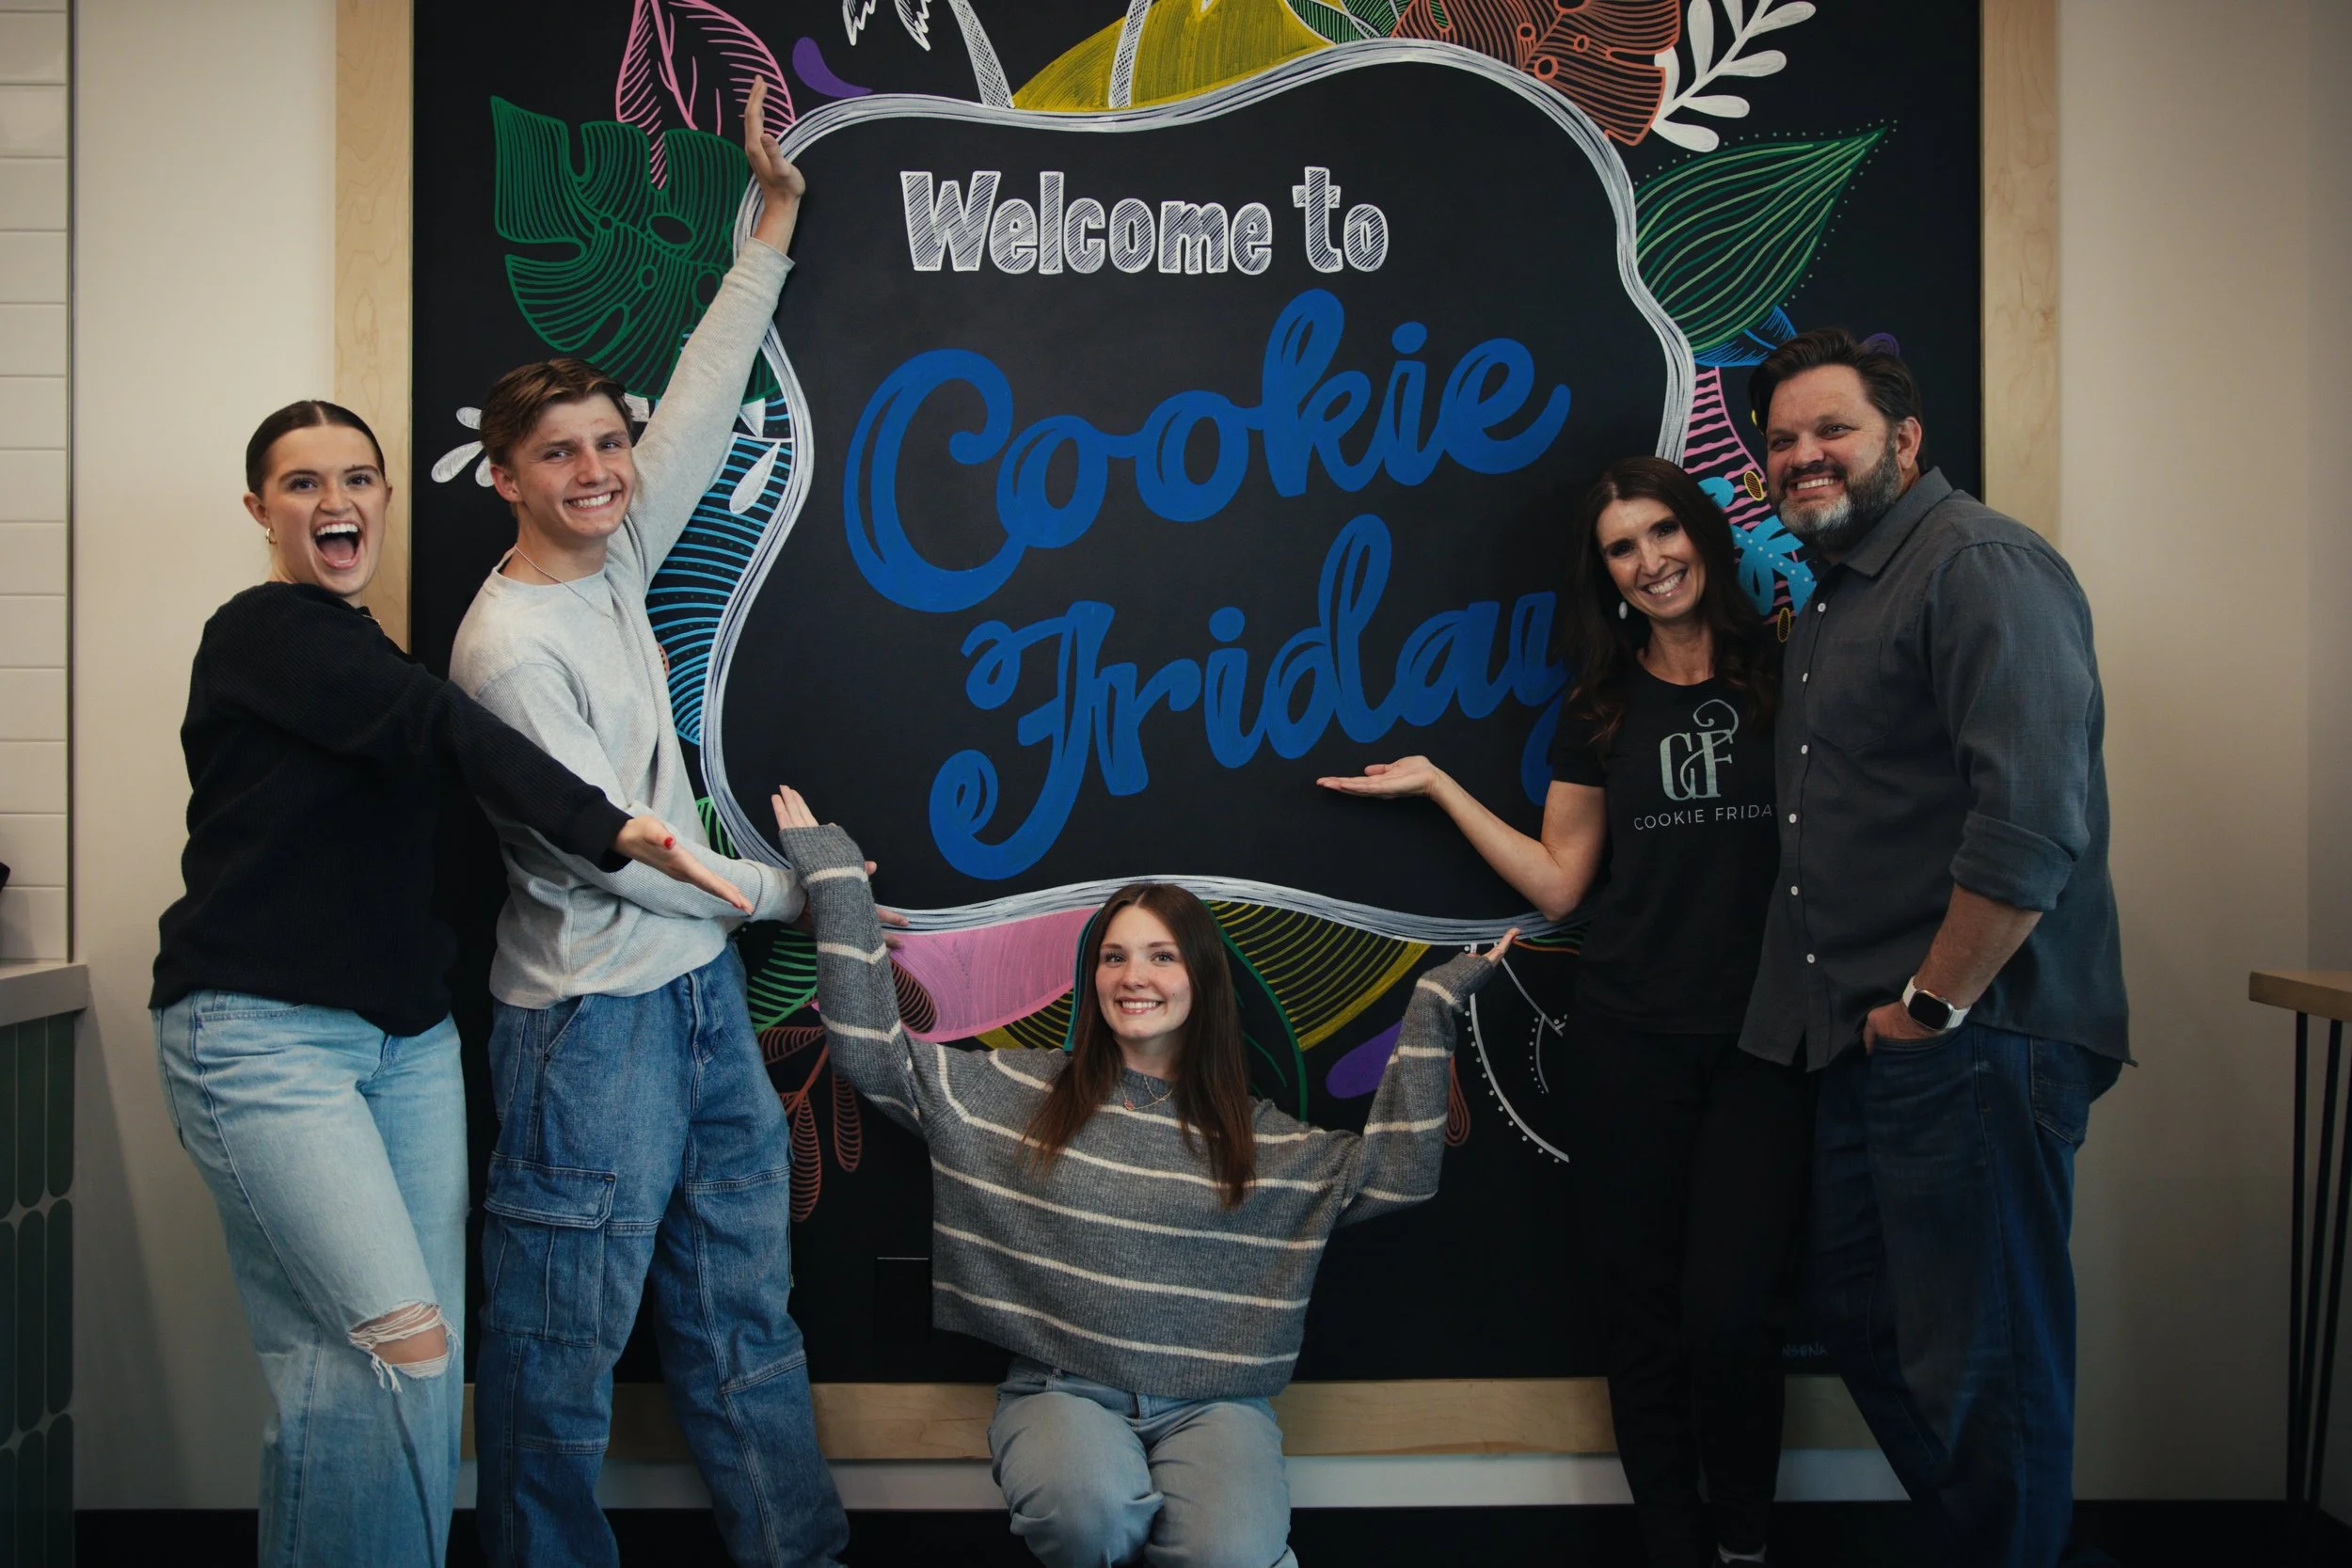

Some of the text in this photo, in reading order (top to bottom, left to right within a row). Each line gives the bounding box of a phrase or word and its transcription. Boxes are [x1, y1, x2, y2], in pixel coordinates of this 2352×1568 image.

[899, 166, 1389, 275] Welcome to
[843, 289, 1572, 612] Cookie
[1633, 803, 1776, 831] COOKIE FRIDA
